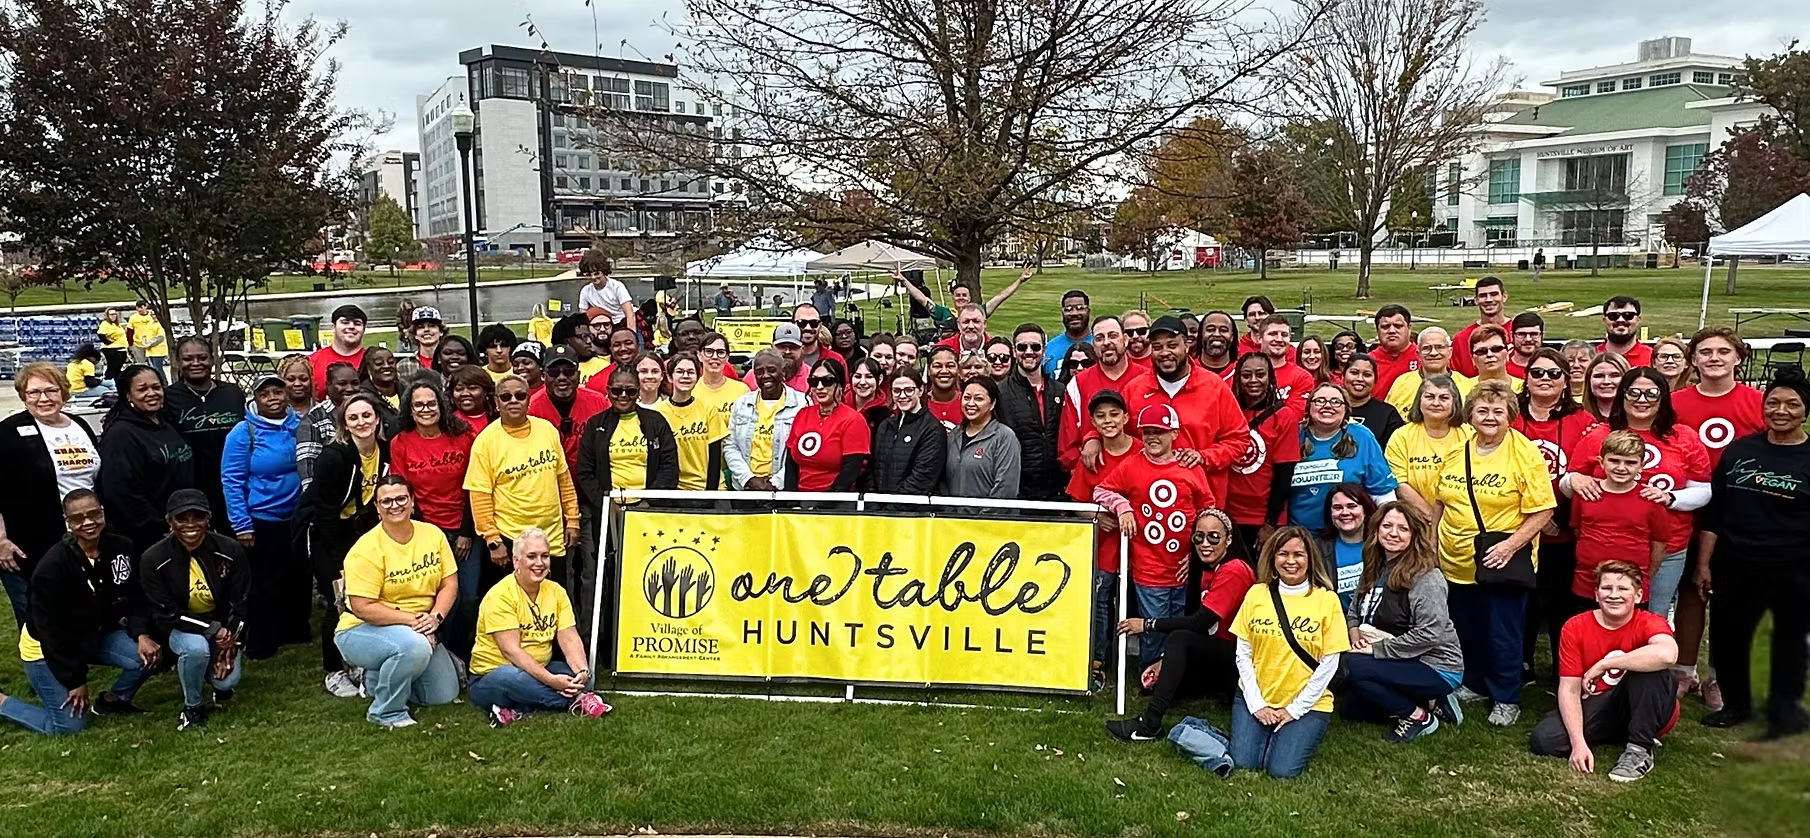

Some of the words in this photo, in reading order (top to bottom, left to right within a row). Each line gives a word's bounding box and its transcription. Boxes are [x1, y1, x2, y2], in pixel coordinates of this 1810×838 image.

[1577, 146, 1605, 156] MUSEUM
[1607, 144, 1617, 152] OF
[1620, 143, 1634, 151] ART
[57, 459, 94, 467] SHARON
[731, 545, 862, 606] one
[864, 541, 1071, 616] table
[651, 622, 689, 637] Village
[691, 624, 704, 635] of
[743, 619, 1047, 655] HUNTSVILLE
[632, 636, 720, 654] PROMISE
